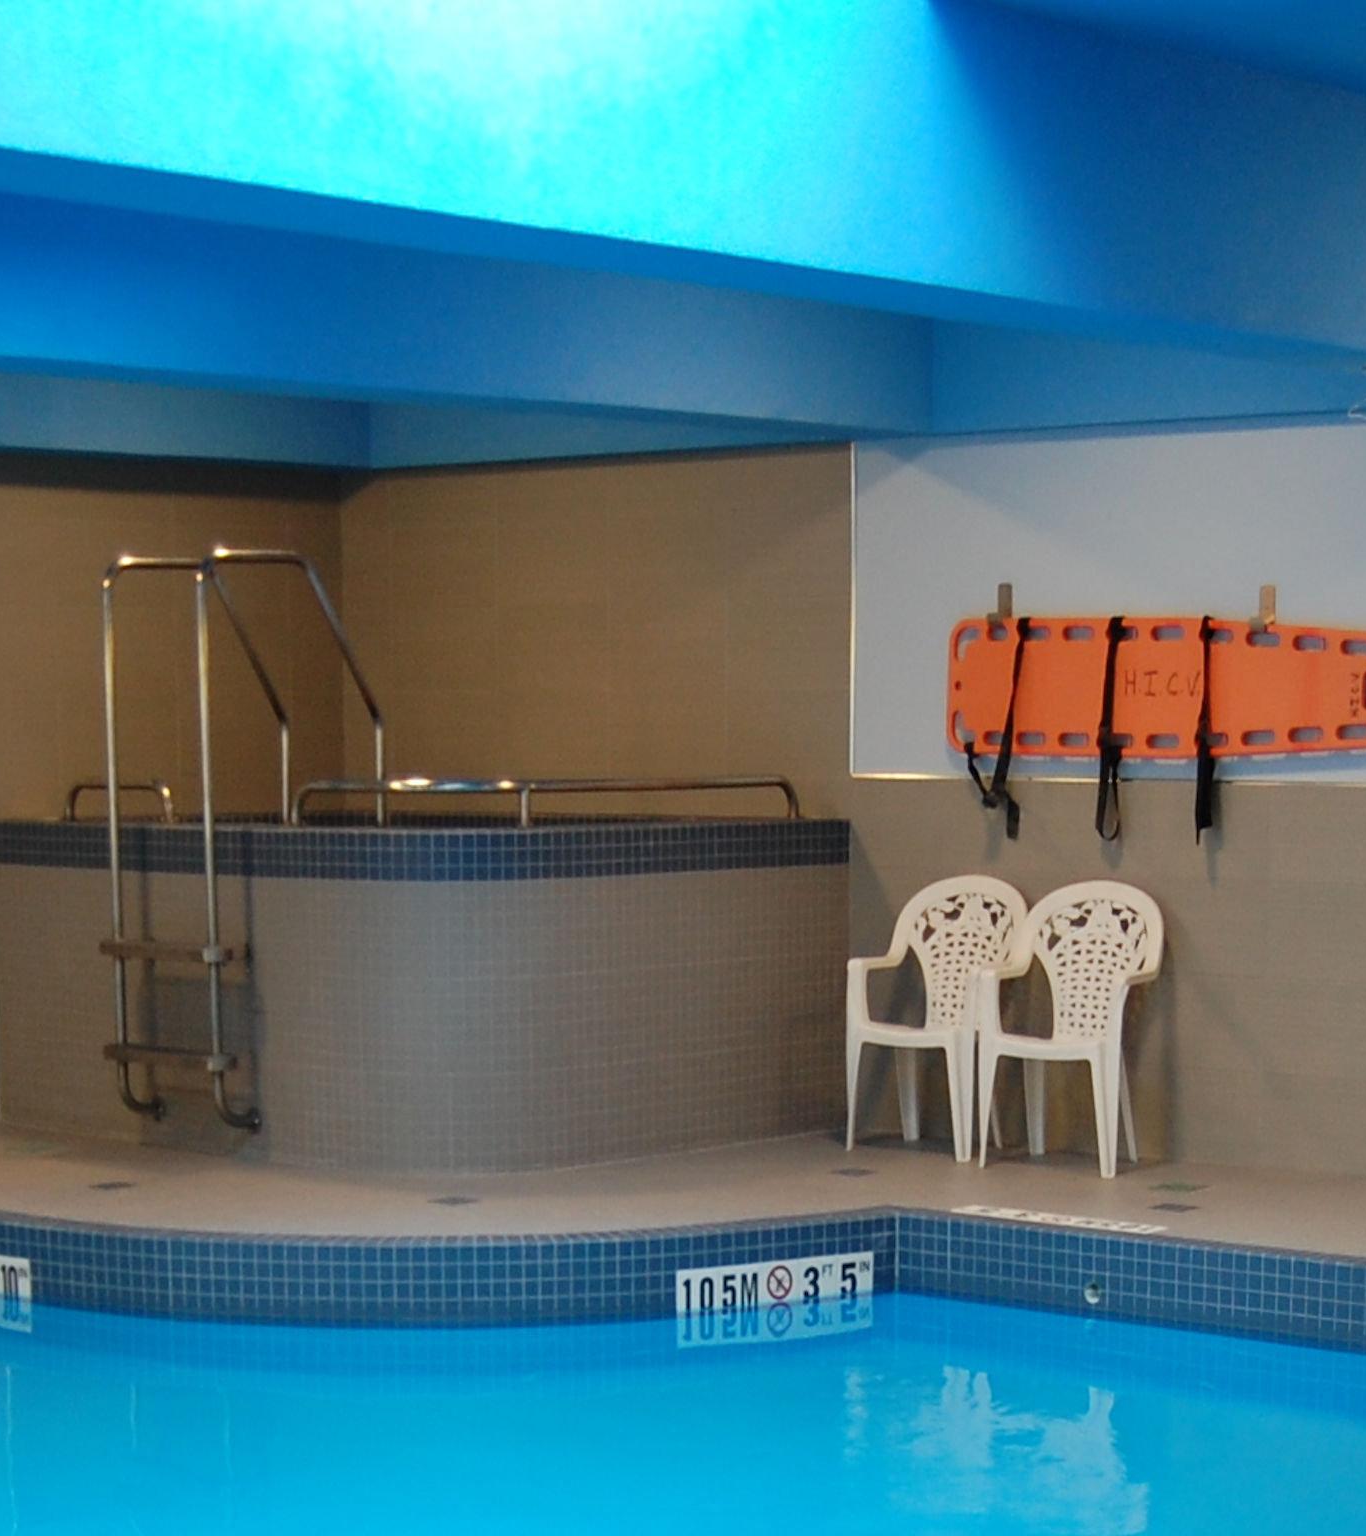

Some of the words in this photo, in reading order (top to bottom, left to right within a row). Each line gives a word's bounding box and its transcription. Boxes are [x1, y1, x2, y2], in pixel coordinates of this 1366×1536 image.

[803, 1266, 820, 1299] 3
[822, 1264, 833, 1277] FT
[841, 1262, 857, 1296] 5
[860, 1261, 870, 1273] IN
